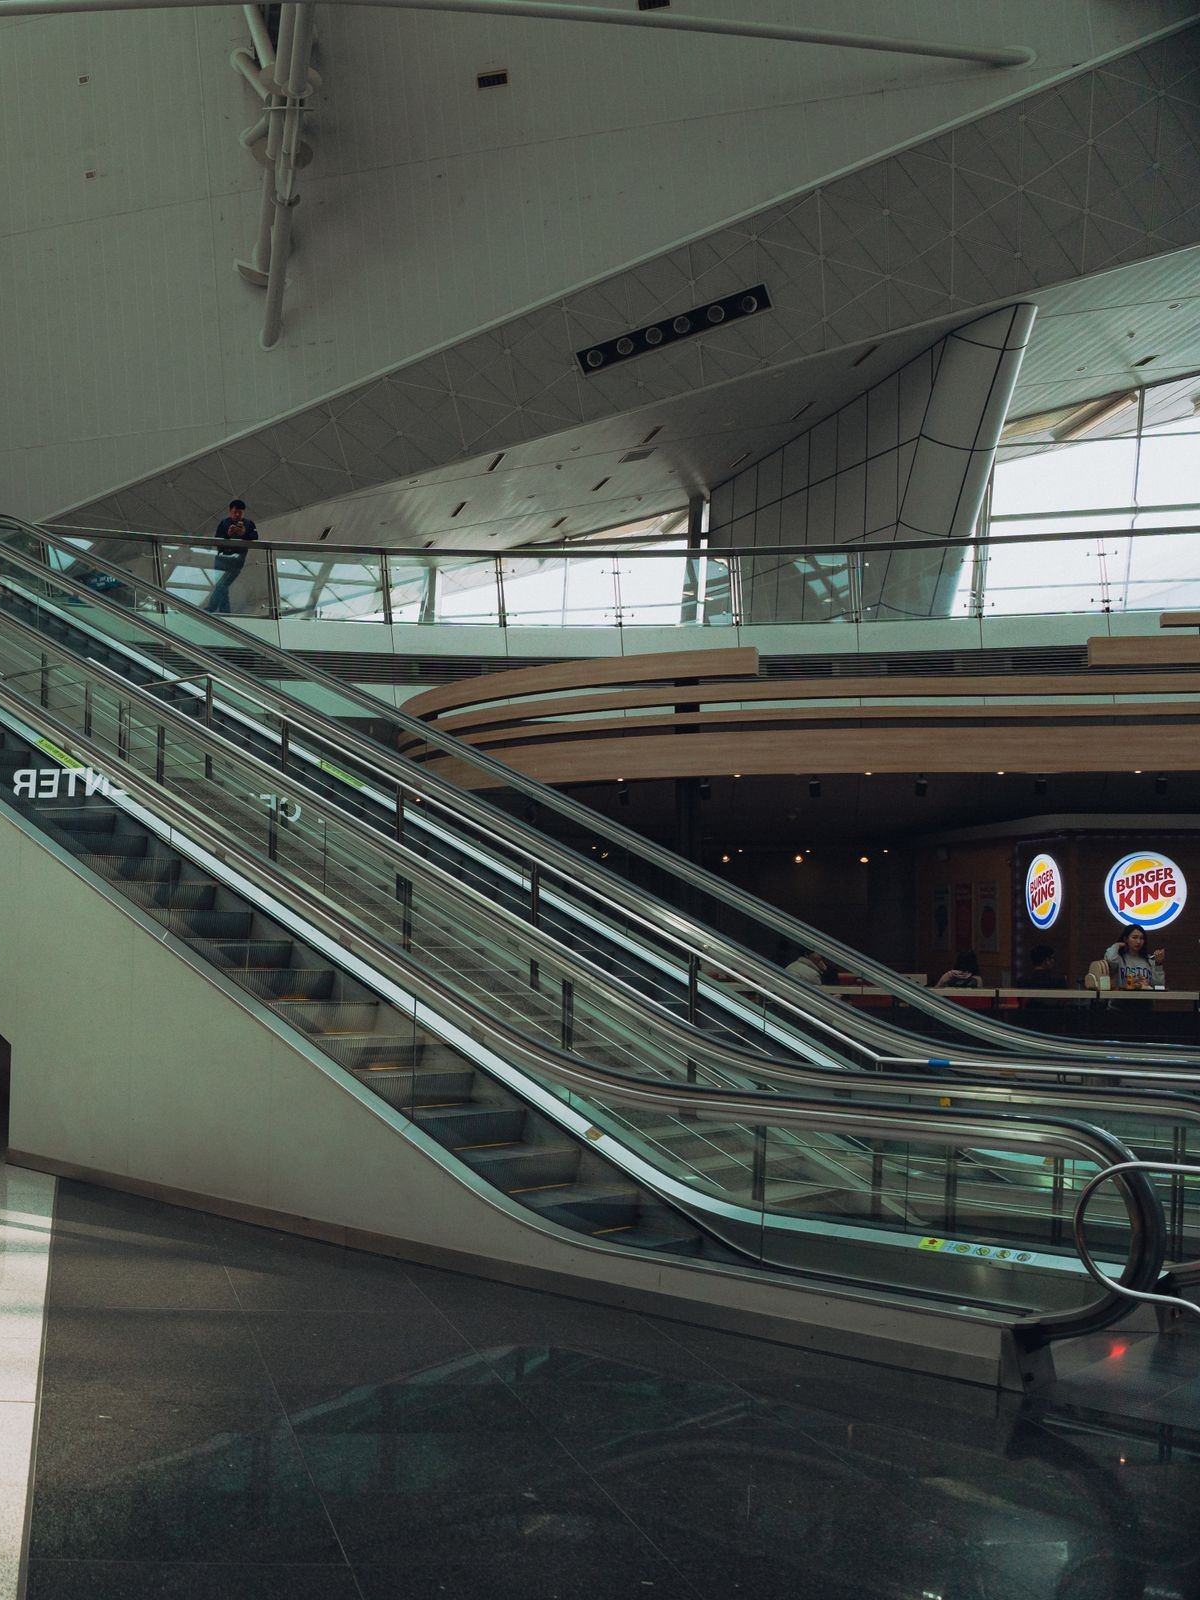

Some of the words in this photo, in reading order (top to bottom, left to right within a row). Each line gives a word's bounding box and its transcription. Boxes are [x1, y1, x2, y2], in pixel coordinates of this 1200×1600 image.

[1029, 869, 1054, 894] BURGER
[1115, 867, 1174, 893] BURGER
[1031, 881, 1055, 912] KING
[1118, 880, 1176, 911] KING
